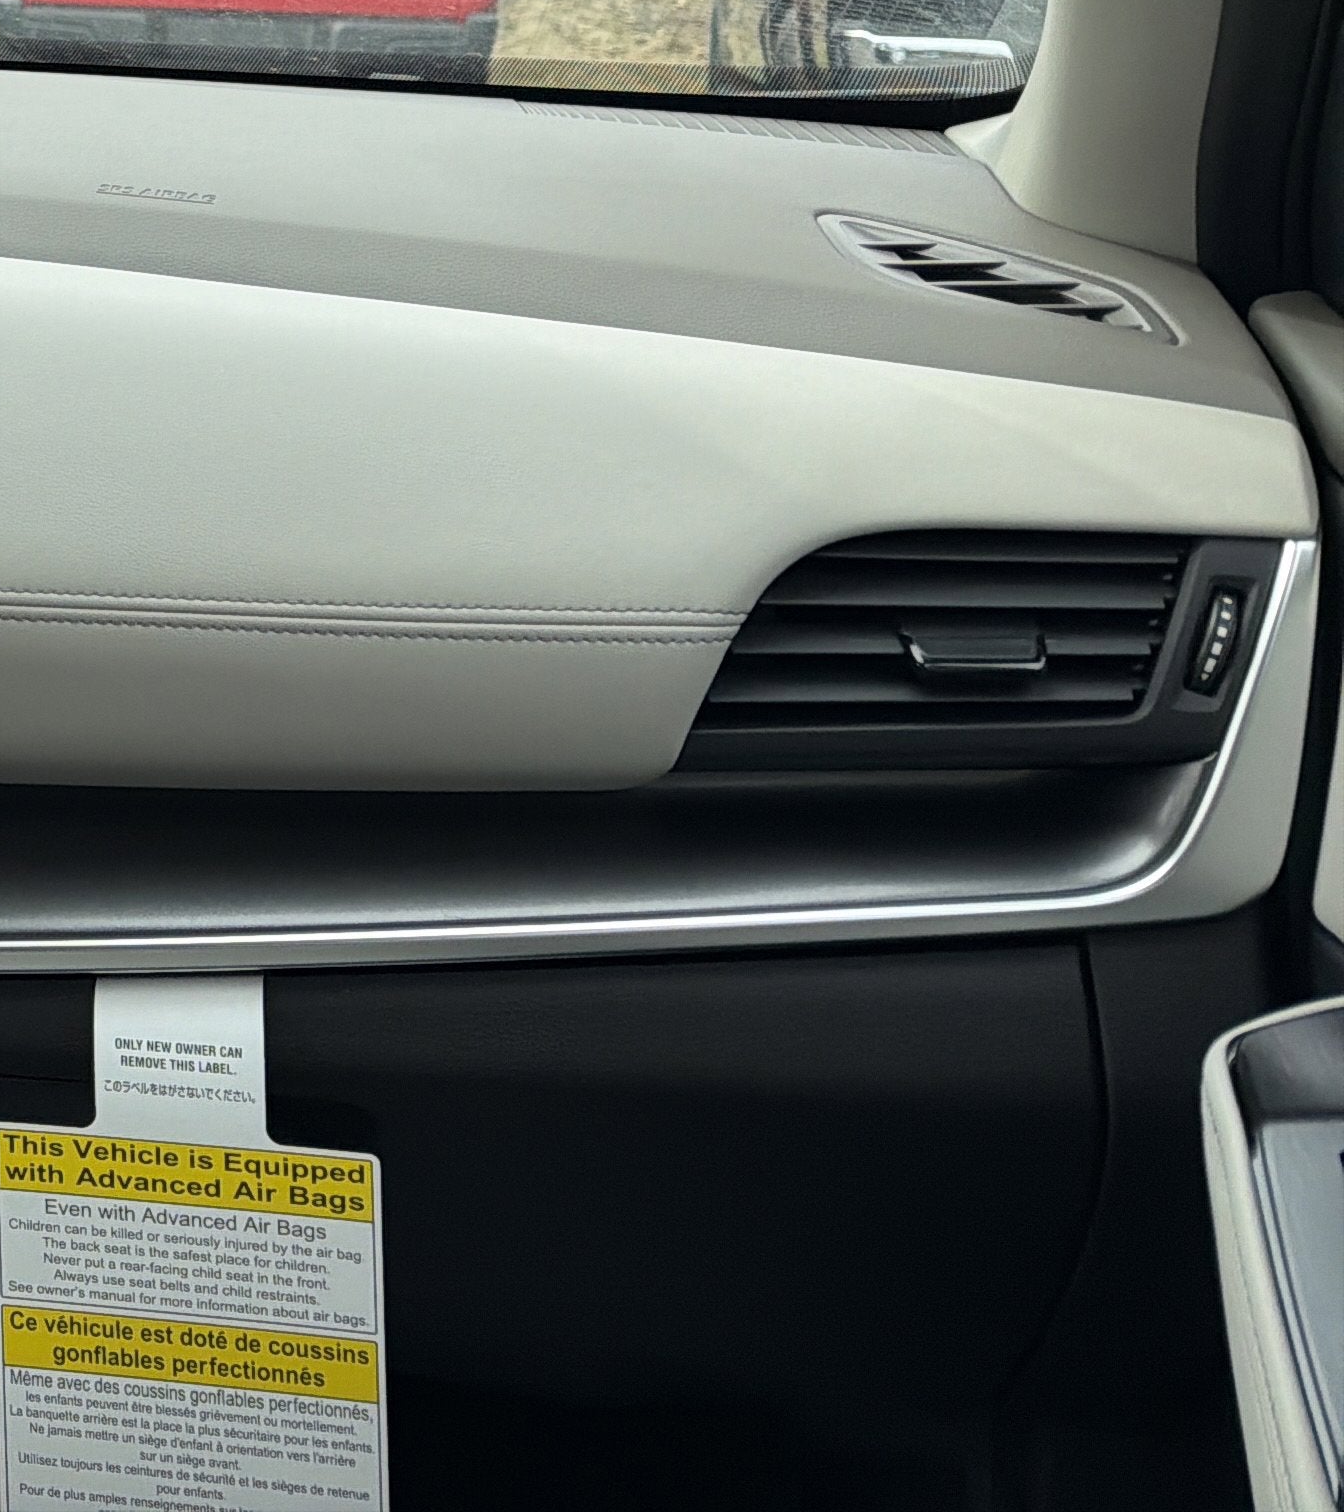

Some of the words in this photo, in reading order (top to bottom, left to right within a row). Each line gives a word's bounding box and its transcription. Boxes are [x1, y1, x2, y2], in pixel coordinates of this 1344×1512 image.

[114, 1037, 143, 1051] ONLY
[146, 1040, 172, 1053] NEW
[175, 1042, 216, 1057] OWNER
[220, 1046, 243, 1059] CAN
[120, 1055, 167, 1070] REMOVE
[169, 1059, 195, 1072] THIS
[3, 1134, 64, 1157] This
[72, 1139, 179, 1167] Vehicle
[189, 1149, 214, 1170] is
[224, 1152, 365, 1185] Equipped
[5, 1163, 64, 1184] with
[76, 1167, 221, 1198] Advanced
[233, 1181, 277, 1202] Air
[289, 1185, 365, 1215] Bags
[8, 1217, 61, 1234] Children
[64, 1225, 88, 1236] can
[91, 1224, 107, 1238] be
[110, 1226, 143, 1241] killed
[146, 1232, 160, 1242] or
[163, 1233, 221, 1251] seriously
[224, 1236, 268, 1253] injured
[272, 1241, 288, 1257] by
[291, 1243, 313, 1257] the
[316, 1247, 334, 1259] air
[44, 1198, 92, 1218] Even
[97, 1204, 135, 1222] with
[141, 1207, 237, 1231] Advanced
[243, 1216, 271, 1234] Air
[277, 1219, 327, 1242] Bags
[42, 1236, 66, 1250] The
[70, 1238, 101, 1253] back
[104, 1244, 132, 1256] seat
[135, 1244, 146, 1257] is
[149, 1246, 169, 1259] the
[172, 1249, 212, 1264] safest
[215, 1252, 250, 1267] place
[253, 1255, 272, 1268] for
[43, 1252, 82, 1266] Never
[84, 1258, 105, 1269] put
[108, 1260, 116, 1270] a
[120, 1261, 188, 1279] rear-facing
[191, 1266, 222, 1280] child
[225, 1271, 254, 1283] seat
[257, 1272, 269, 1284] in
[272, 1274, 293, 1287] the
[8, 1280, 33, 1294] See
[89, 1290, 136, 1303] manual
[139, 1292, 157, 1305] for
[160, 1297, 193, 1309] more
[196, 1298, 269, 1316] information
[272, 1306, 309, 1321] about
[312, 1310, 331, 1322] air
[53, 1269, 99, 1285] Always
[102, 1275, 125, 1287] use
[129, 1278, 156, 1290] seat
[159, 1279, 191, 1293] belts
[194, 1283, 219, 1296] and
[222, 1285, 252, 1299] child
[9, 1310, 37, 1331] Ce
[44, 1315, 134, 1341] véhicule
[140, 1326, 174, 1345] est
[180, 1327, 228, 1350] doté
[234, 1332, 261, 1353] de
[268, 1340, 369, 1365] coussins
[53, 1345, 165, 1371] gonflables
[172, 1356, 325, 1388] perfectionnés
[10, 1368, 53, 1389] Même
[57, 1377, 91, 1392] avec
[94, 1377, 120, 1395] des
[123, 1383, 186, 1402] coussins
[190, 1389, 265, 1410] gonflables
